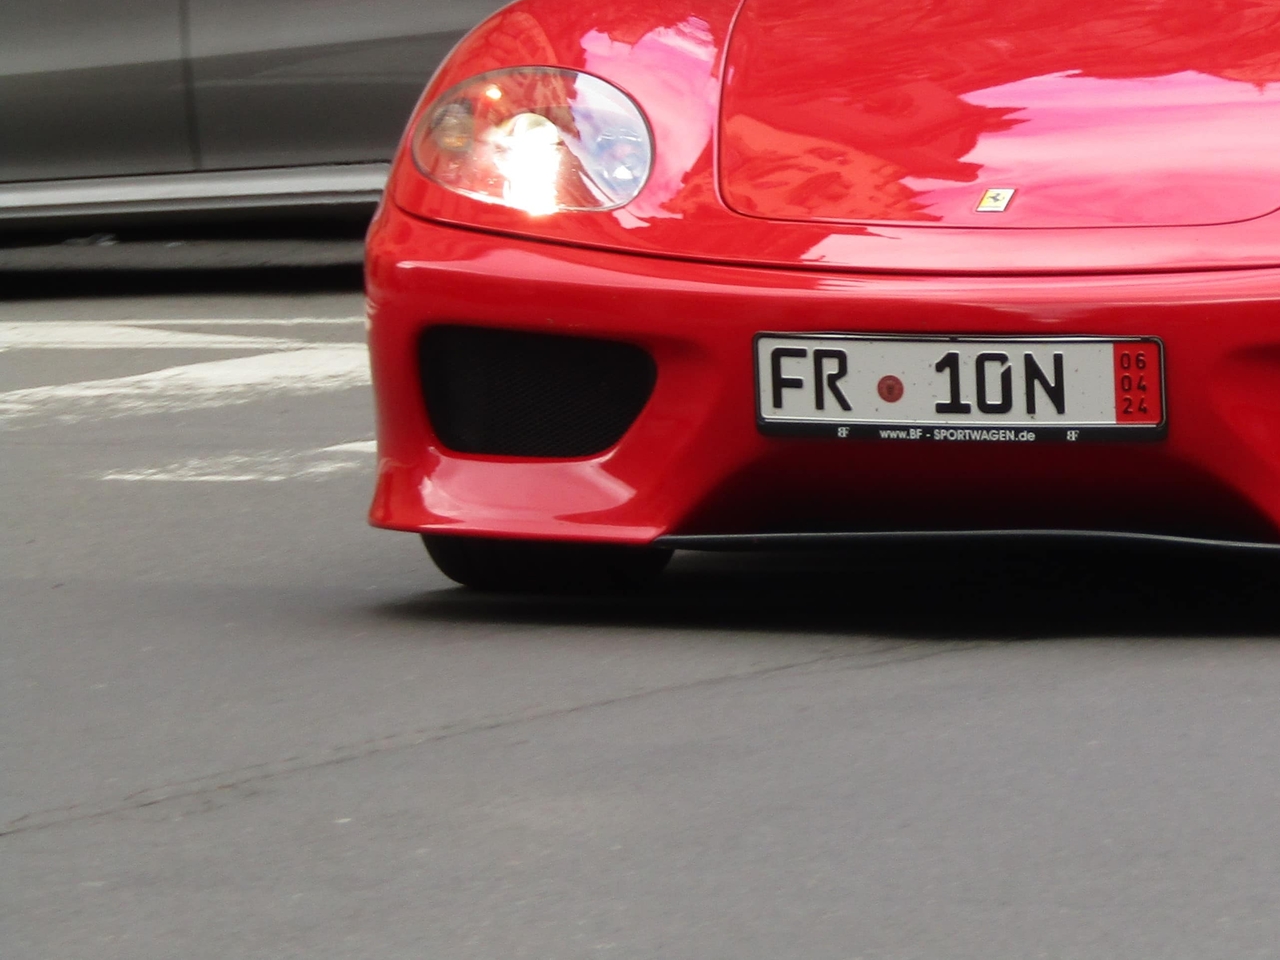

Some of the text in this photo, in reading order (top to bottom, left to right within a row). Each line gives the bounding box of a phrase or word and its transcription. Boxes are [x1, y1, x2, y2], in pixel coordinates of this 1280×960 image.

[1120, 351, 1146, 370] 06
[770, 346, 1066, 415] FR 10N
[1121, 373, 1147, 392] 04
[1122, 396, 1148, 415] 24
